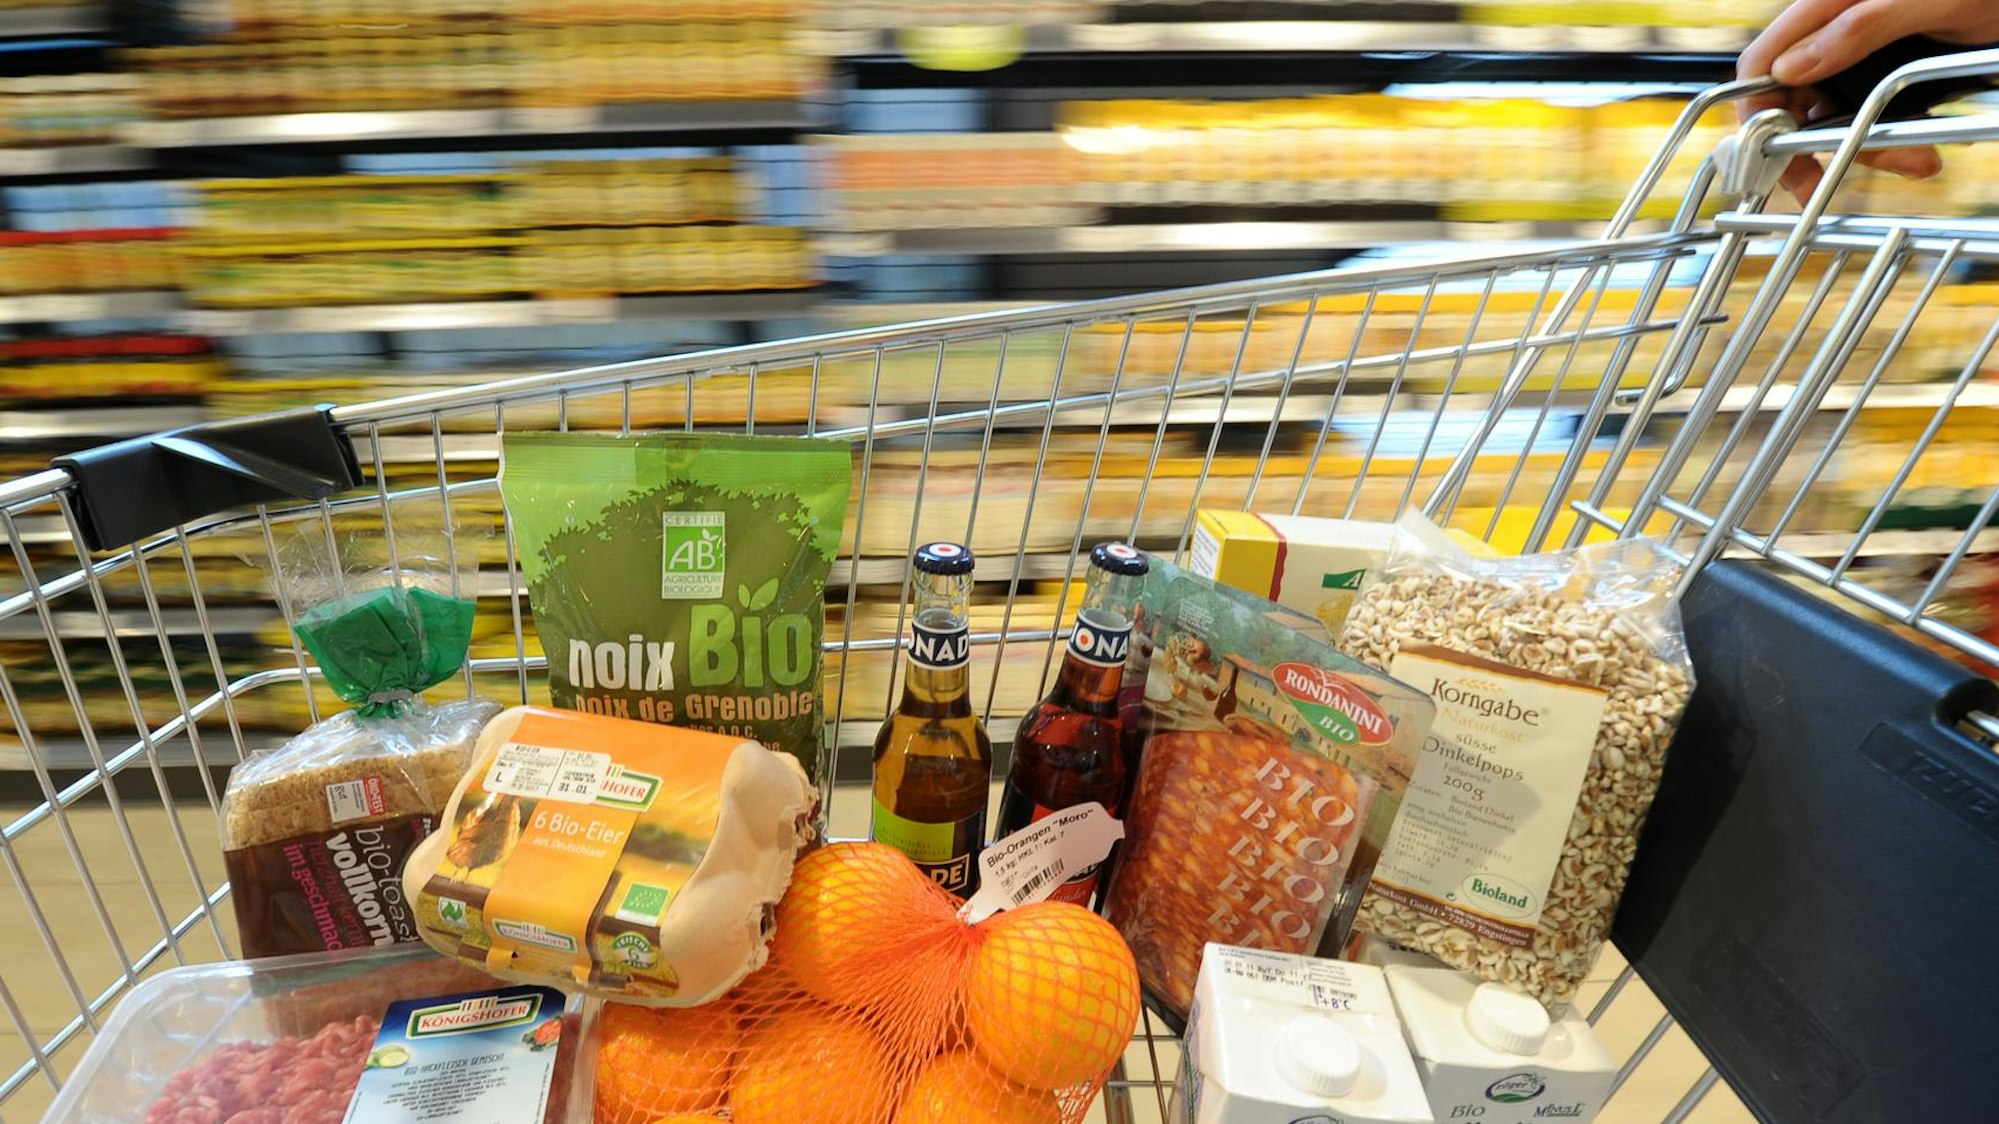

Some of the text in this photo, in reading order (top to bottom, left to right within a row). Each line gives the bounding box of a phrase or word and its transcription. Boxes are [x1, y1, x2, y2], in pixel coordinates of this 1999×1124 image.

[669, 538, 717, 571] AB
[568, 604, 813, 692] noix Bio
[638, 696, 674, 723] de
[685, 690, 813, 721] Grenoble
[1284, 668, 1384, 735] RONDANINI
[1318, 715, 1355, 742] BIO
[1422, 735, 1525, 781] Dinkelpops
[1253, 757, 1355, 827] BIO
[1443, 775, 1486, 802] 200g
[533, 810, 625, 845] 6 Bio-Eier
[986, 825, 1052, 868] Bio-Orangen
[1240, 797, 1339, 867] BIO
[325, 831, 396, 947] vollkorn
[355, 825, 420, 942] bio-toast
[930, 863, 964, 886] DE
[1227, 835, 1326, 904] BIO
[282, 842, 346, 953] im geschmac
[1216, 870, 1312, 940] BIO
[1471, 878, 1528, 910] Bioland
[421, 1005, 527, 1028] KÖNIGSHOFER
[1449, 1104, 1486, 1119] Bio
